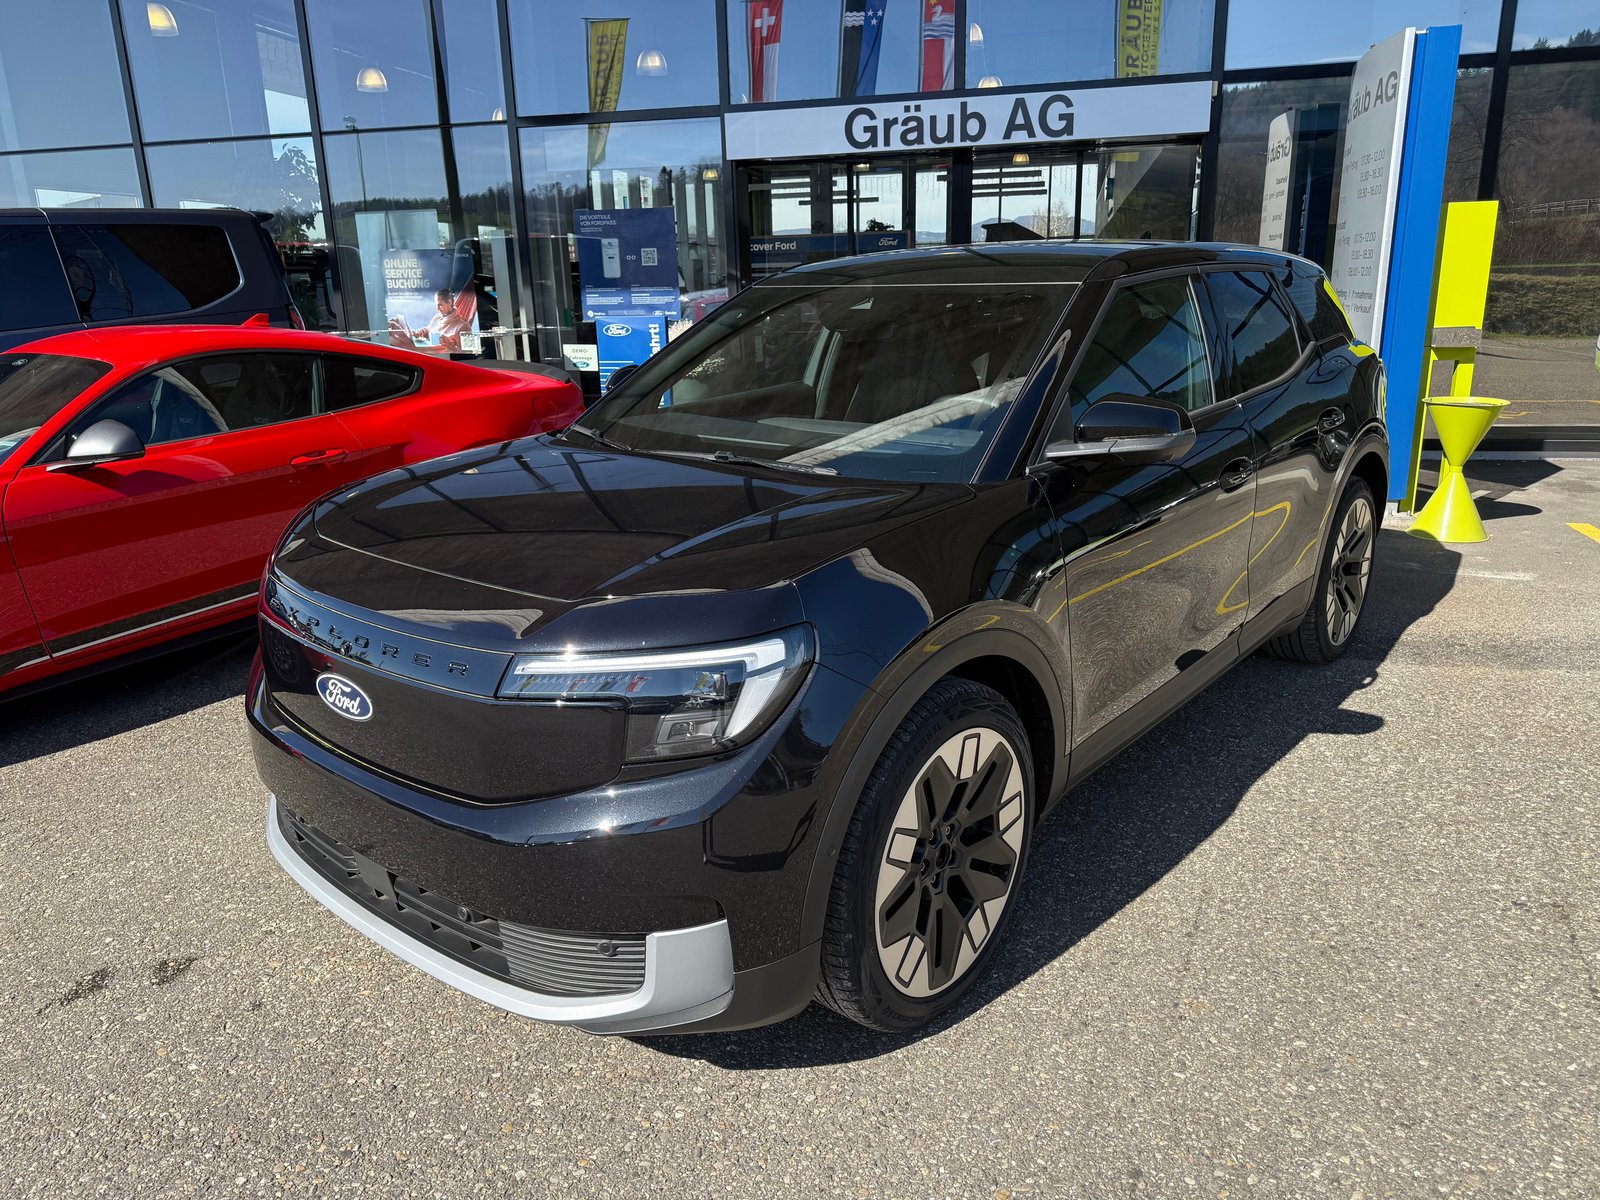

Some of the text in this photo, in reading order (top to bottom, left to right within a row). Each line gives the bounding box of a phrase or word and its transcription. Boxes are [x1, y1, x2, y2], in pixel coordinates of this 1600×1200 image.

[1373, 70, 1398, 108] AG
[844, 93, 1075, 150] Gräub AG
[774, 240, 797, 250] Ford
[878, 237, 898, 246] Ford
[383, 258, 418, 269] ONLINE
[385, 269, 423, 279] SERVICE
[387, 279, 430, 289] BUCHUNG
[606, 325, 629, 337] Ford
[269, 597, 469, 677] EXPLORER
[322, 677, 362, 716] Ford
